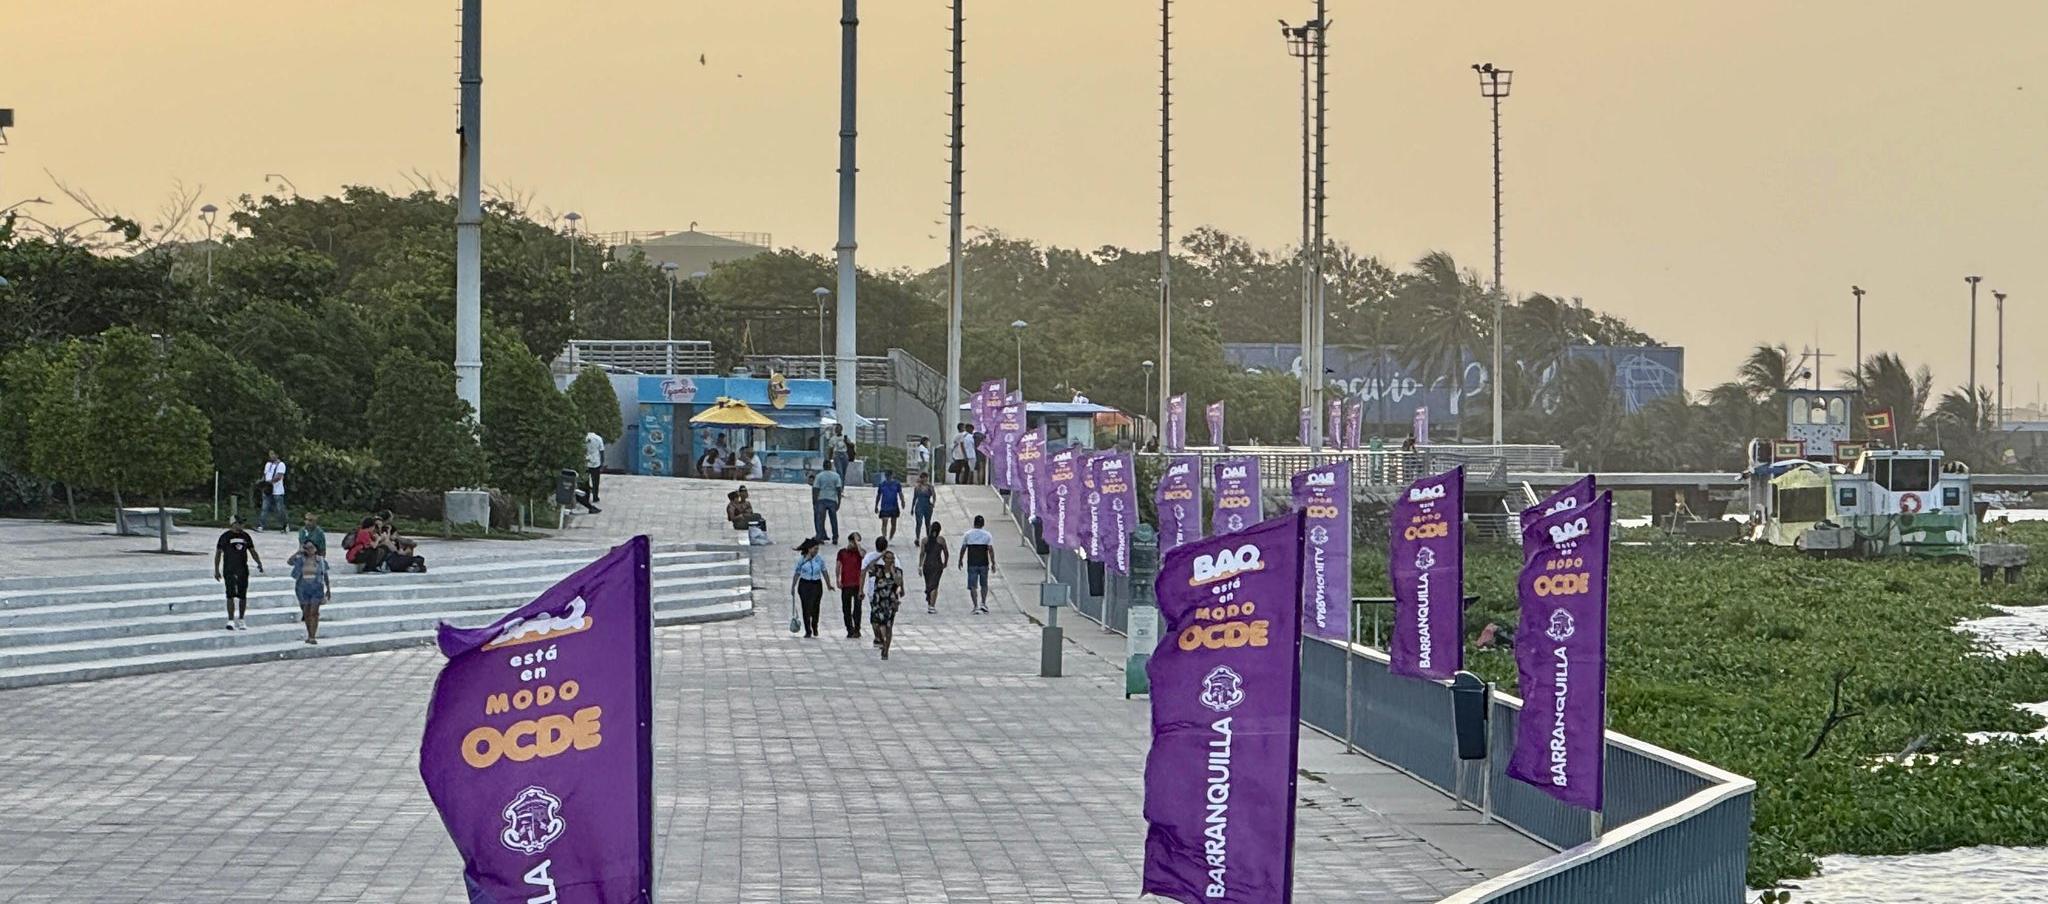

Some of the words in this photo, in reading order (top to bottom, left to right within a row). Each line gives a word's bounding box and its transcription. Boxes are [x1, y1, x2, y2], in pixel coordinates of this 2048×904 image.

[1410, 484, 1445, 500] BAQ
[1404, 521, 1448, 541] OCDE
[1549, 517, 1589, 544] BAQ
[1193, 544, 1262, 582] BAQ
[1546, 557, 1583, 571] MODO
[1212, 577, 1241, 595] está
[1533, 572, 1590, 597] OCDE
[1195, 601, 1256, 621] MODO
[1418, 573, 1431, 668] BARRANQUILLA
[1178, 620, 1270, 652] OCDE
[510, 644, 558, 667] está
[520, 666, 547, 681] en
[485, 680, 580, 715] MODO
[1553, 646, 1568, 787] BARRANQUILLA
[461, 706, 602, 768] OCDE
[1206, 716, 1233, 898] BARRANQUILLA
